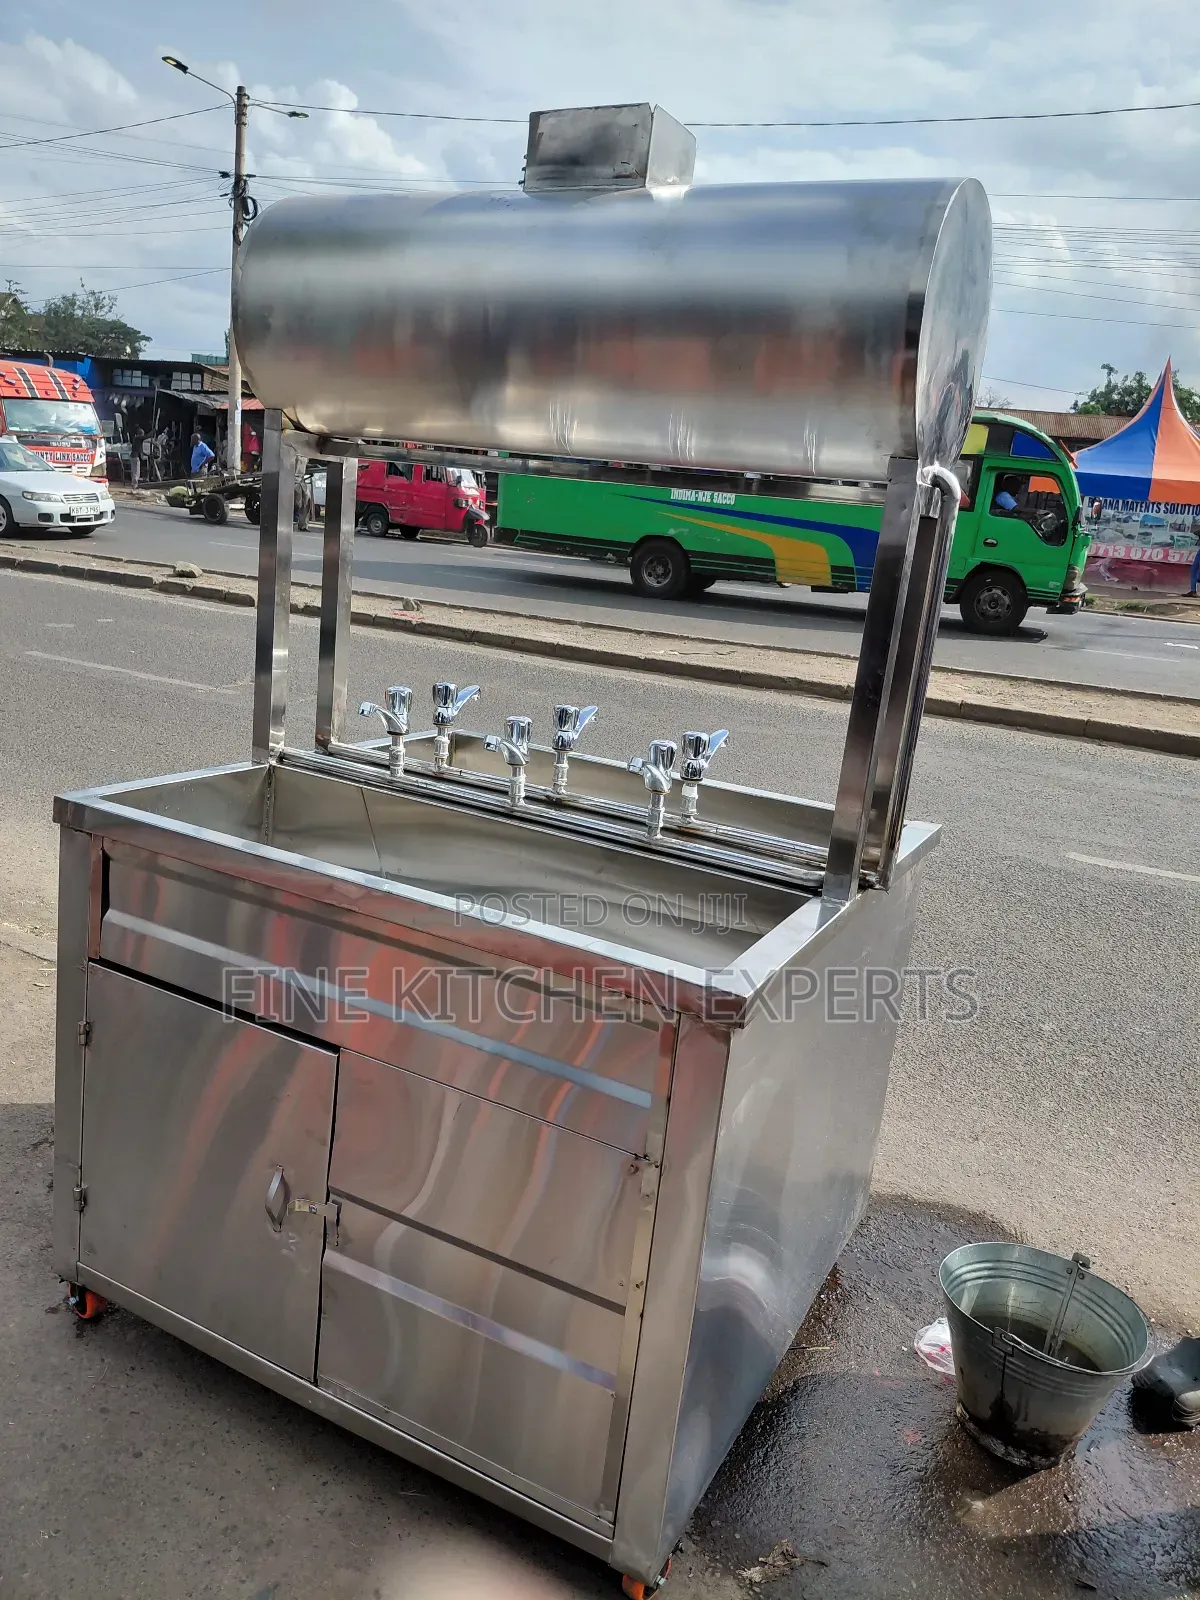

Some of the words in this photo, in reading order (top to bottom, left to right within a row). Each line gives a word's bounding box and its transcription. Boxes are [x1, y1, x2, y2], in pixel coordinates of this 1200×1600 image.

[55, 452, 71, 462] LINK
[72, 453, 91, 462] SACCO
[713, 491, 735, 505] SACCO
[1087, 496, 1120, 511] BANA
[1120, 499, 1161, 514] MATENTS
[1129, 546, 1164, 561] 070
